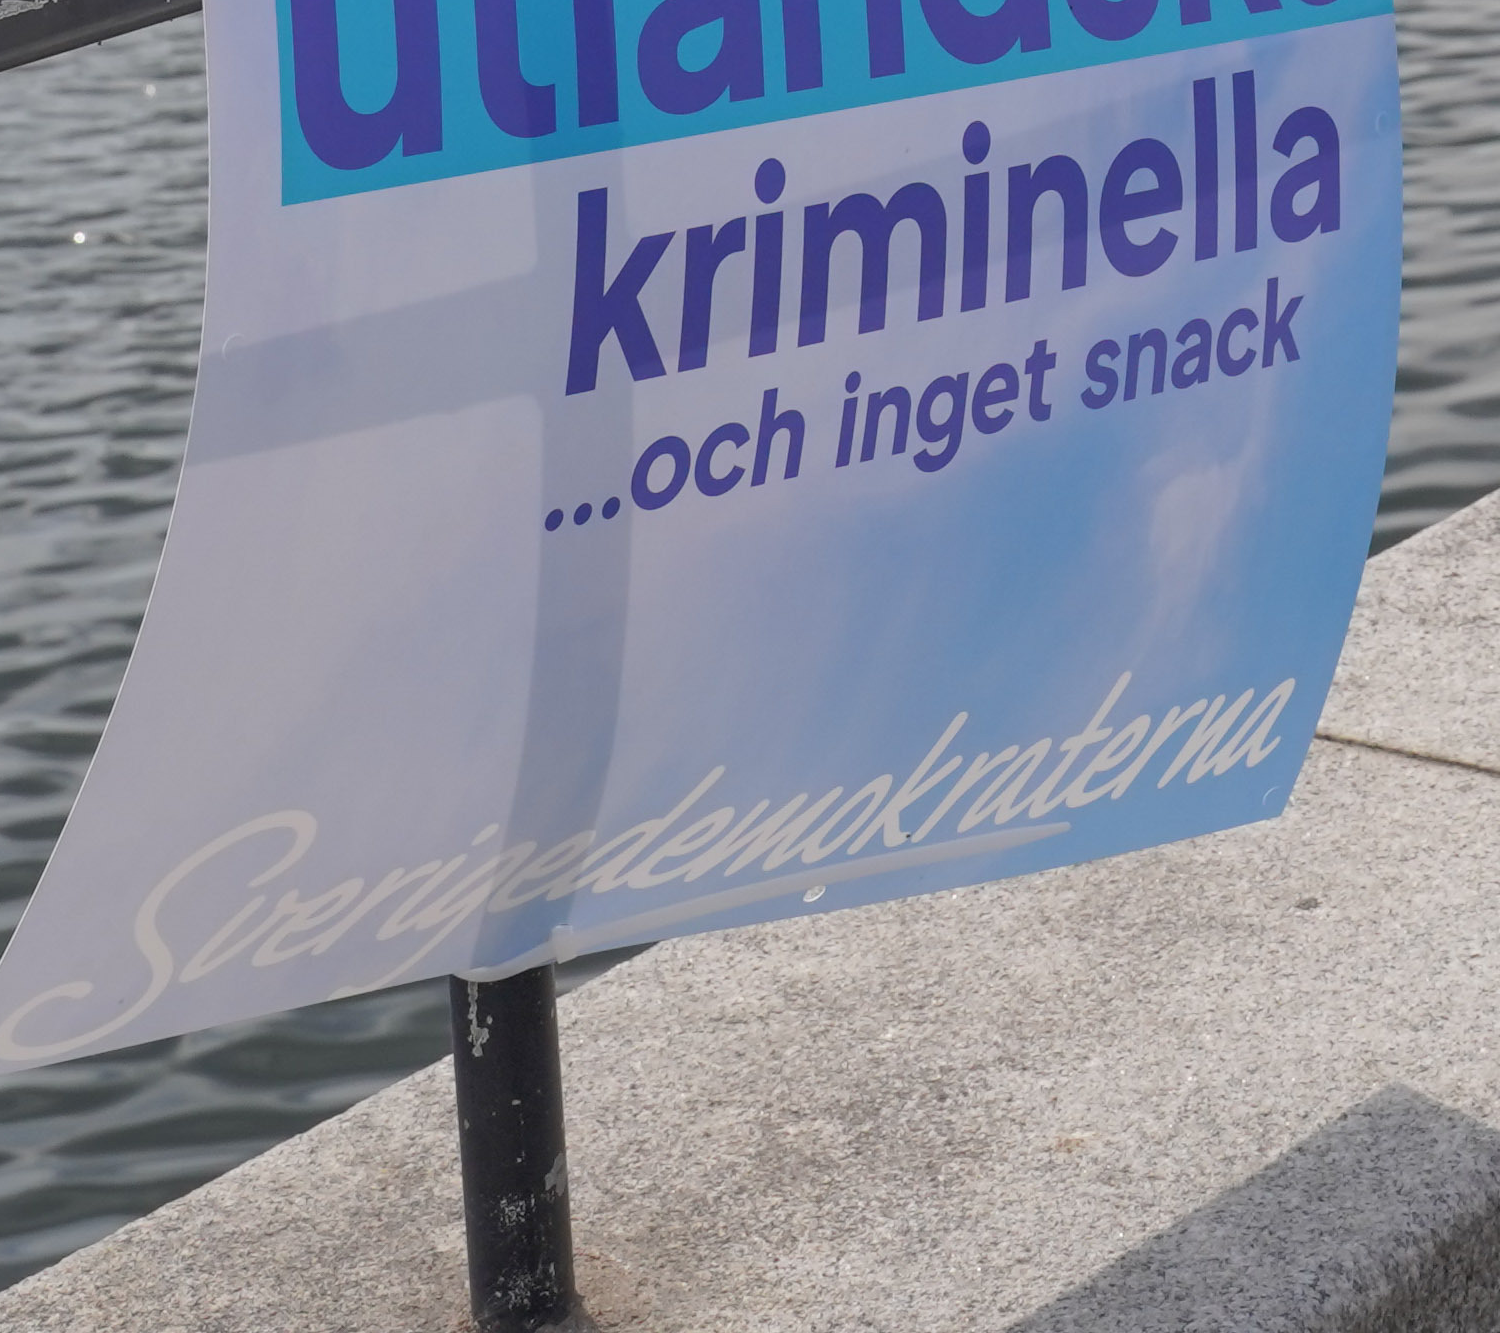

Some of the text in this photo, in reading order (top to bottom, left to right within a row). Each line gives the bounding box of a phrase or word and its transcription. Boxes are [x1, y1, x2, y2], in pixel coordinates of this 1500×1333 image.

[565, 70, 1342, 396] kriminella
[544, 276, 1304, 532] ...och inget snack
